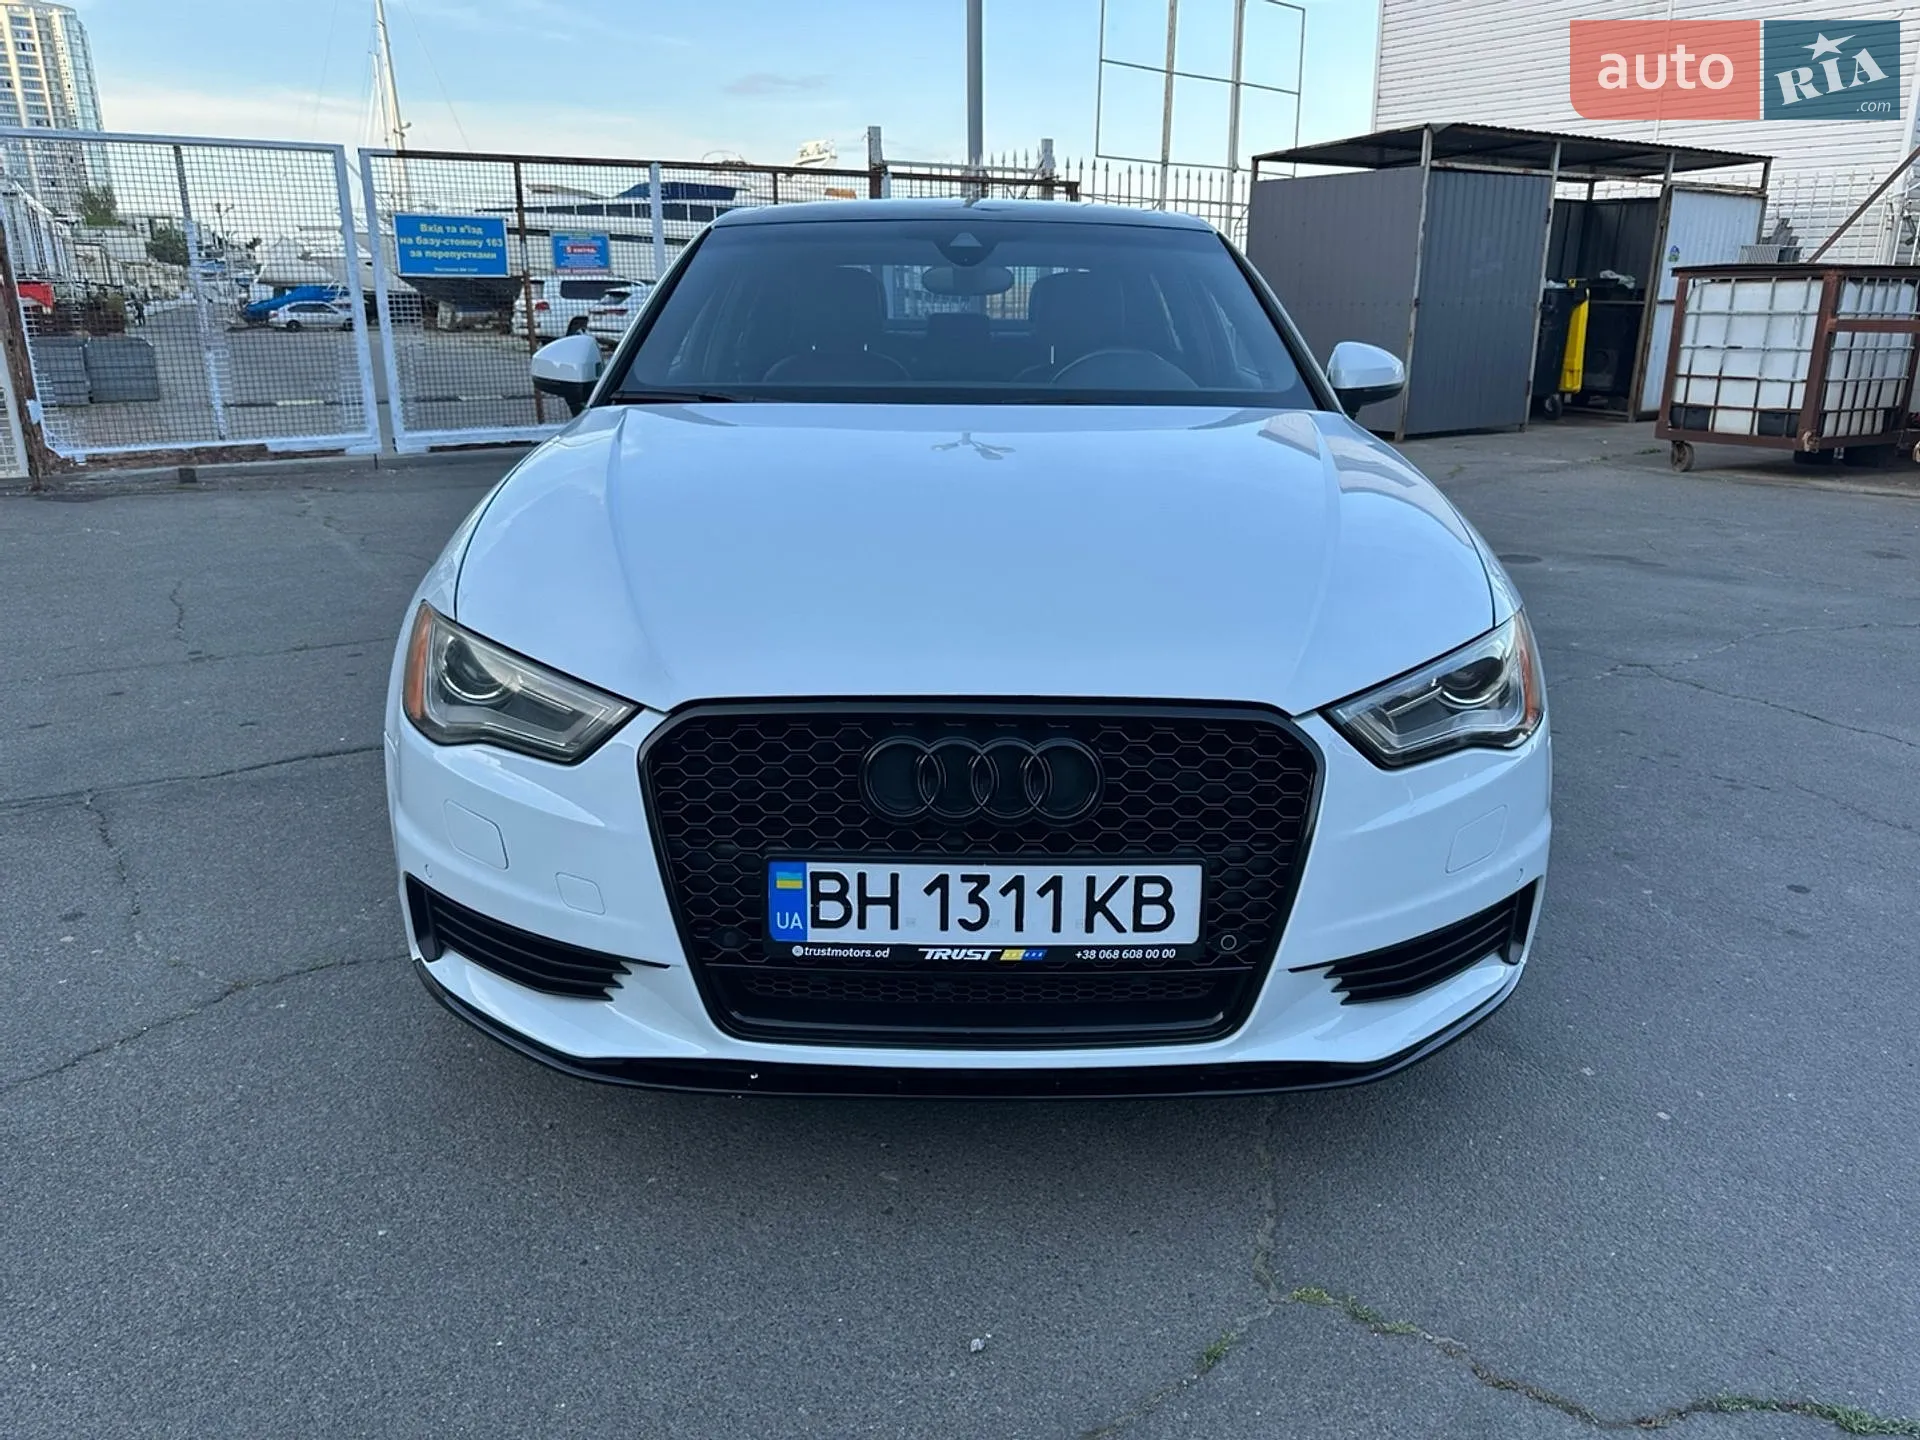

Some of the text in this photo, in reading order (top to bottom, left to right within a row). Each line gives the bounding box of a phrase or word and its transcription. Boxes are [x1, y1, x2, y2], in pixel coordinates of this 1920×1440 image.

[420, 223, 444, 234] Вхід
[446, 225, 457, 234] та
[400, 237, 413, 245] на
[415, 236, 483, 249] базу-стоянку
[409, 250, 497, 260] за перепустками
[809, 871, 1176, 934] BH 1311 KB
[776, 911, 804, 930] UA
[918, 948, 1002, 960] TRUST
[1075, 948, 1176, 960] +38 068 608 00 00
